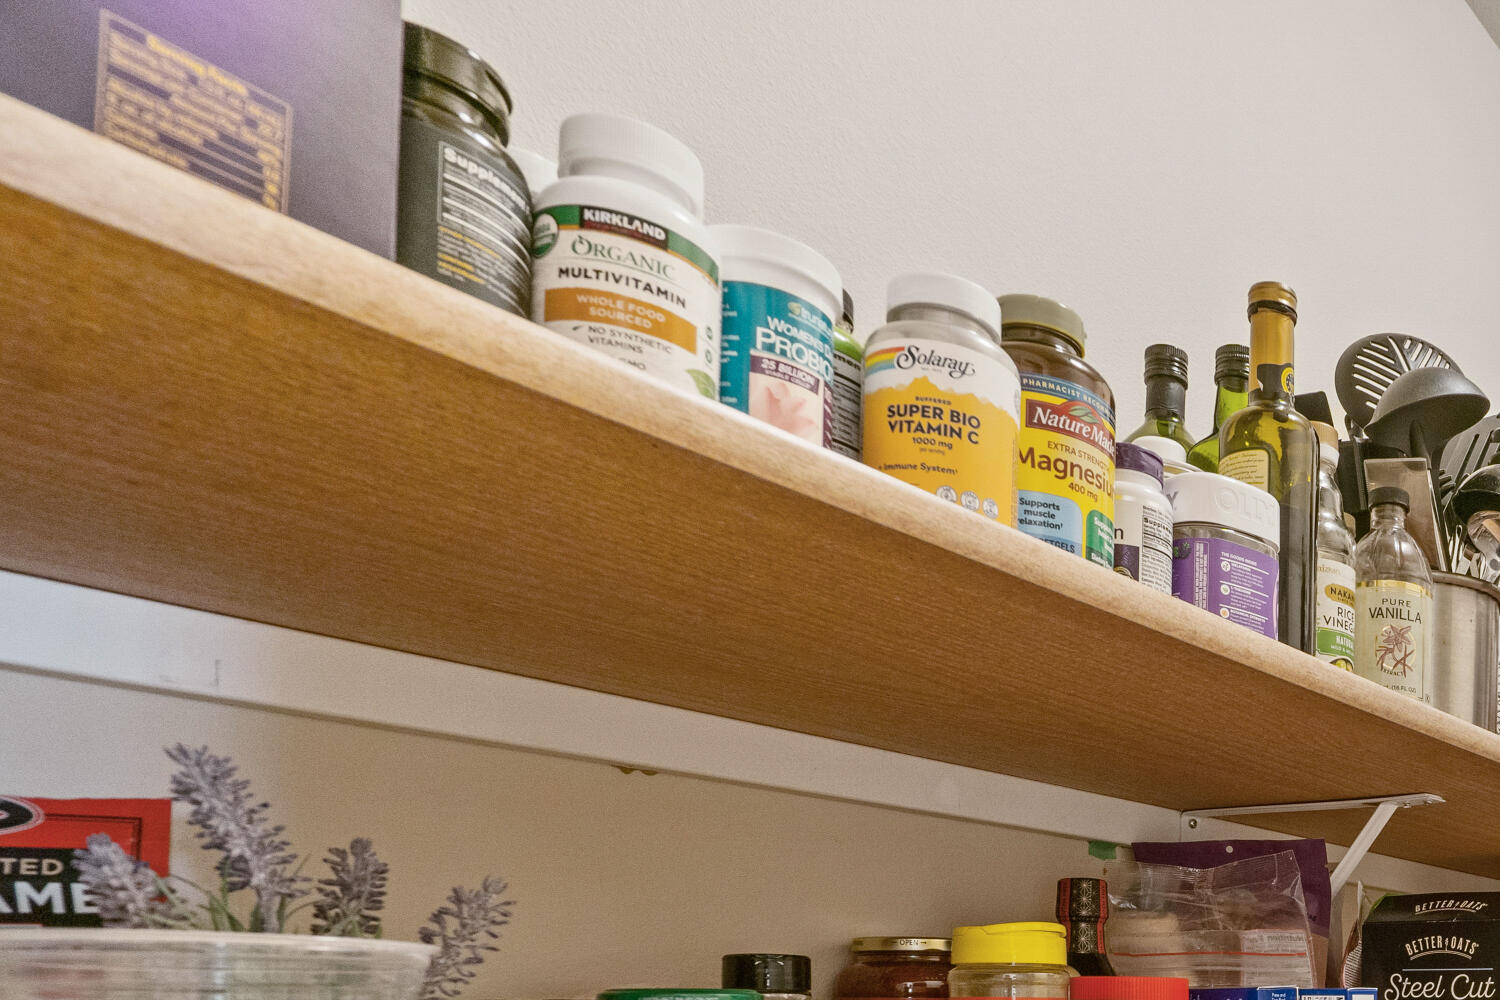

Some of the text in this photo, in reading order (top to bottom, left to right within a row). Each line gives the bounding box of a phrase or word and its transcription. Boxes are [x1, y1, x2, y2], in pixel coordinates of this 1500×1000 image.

[583, 208, 666, 241] KIRKLAND
[571, 235, 675, 280] ORGANIC
[558, 266, 686, 308] MULTIVITAMIN
[576, 294, 666, 322] WHOLE FOOD
[589, 307, 652, 328] SOURCED
[588, 335, 644, 354] VITAMINS
[610, 327, 672, 354] SYNTHETIC
[761, 358, 776, 371] 25
[778, 363, 816, 386] BILLION
[896, 345, 976, 379] Solaray
[1022, 377, 1081, 399] PHARMACIST
[887, 404, 981, 429] SUPER BIO
[888, 420, 980, 445] VITAMIN C
[912, 436, 953, 450] 1000 mg
[1047, 441, 1077, 456] EXTRA
[884, 463, 917, 471] Immune
[1068, 481, 1098, 503] 400 mg
[1019, 497, 1061, 511] Supports
[1023, 508, 1056, 520] muscle
[1382, 597, 1411, 608] PURE
[1368, 607, 1422, 625] VANILLA
[1415, 899, 1485, 912] BETTER OATS
[1405, 935, 1476, 956] BETTER OATS
[1451, 973, 1496, 1000] Cut
